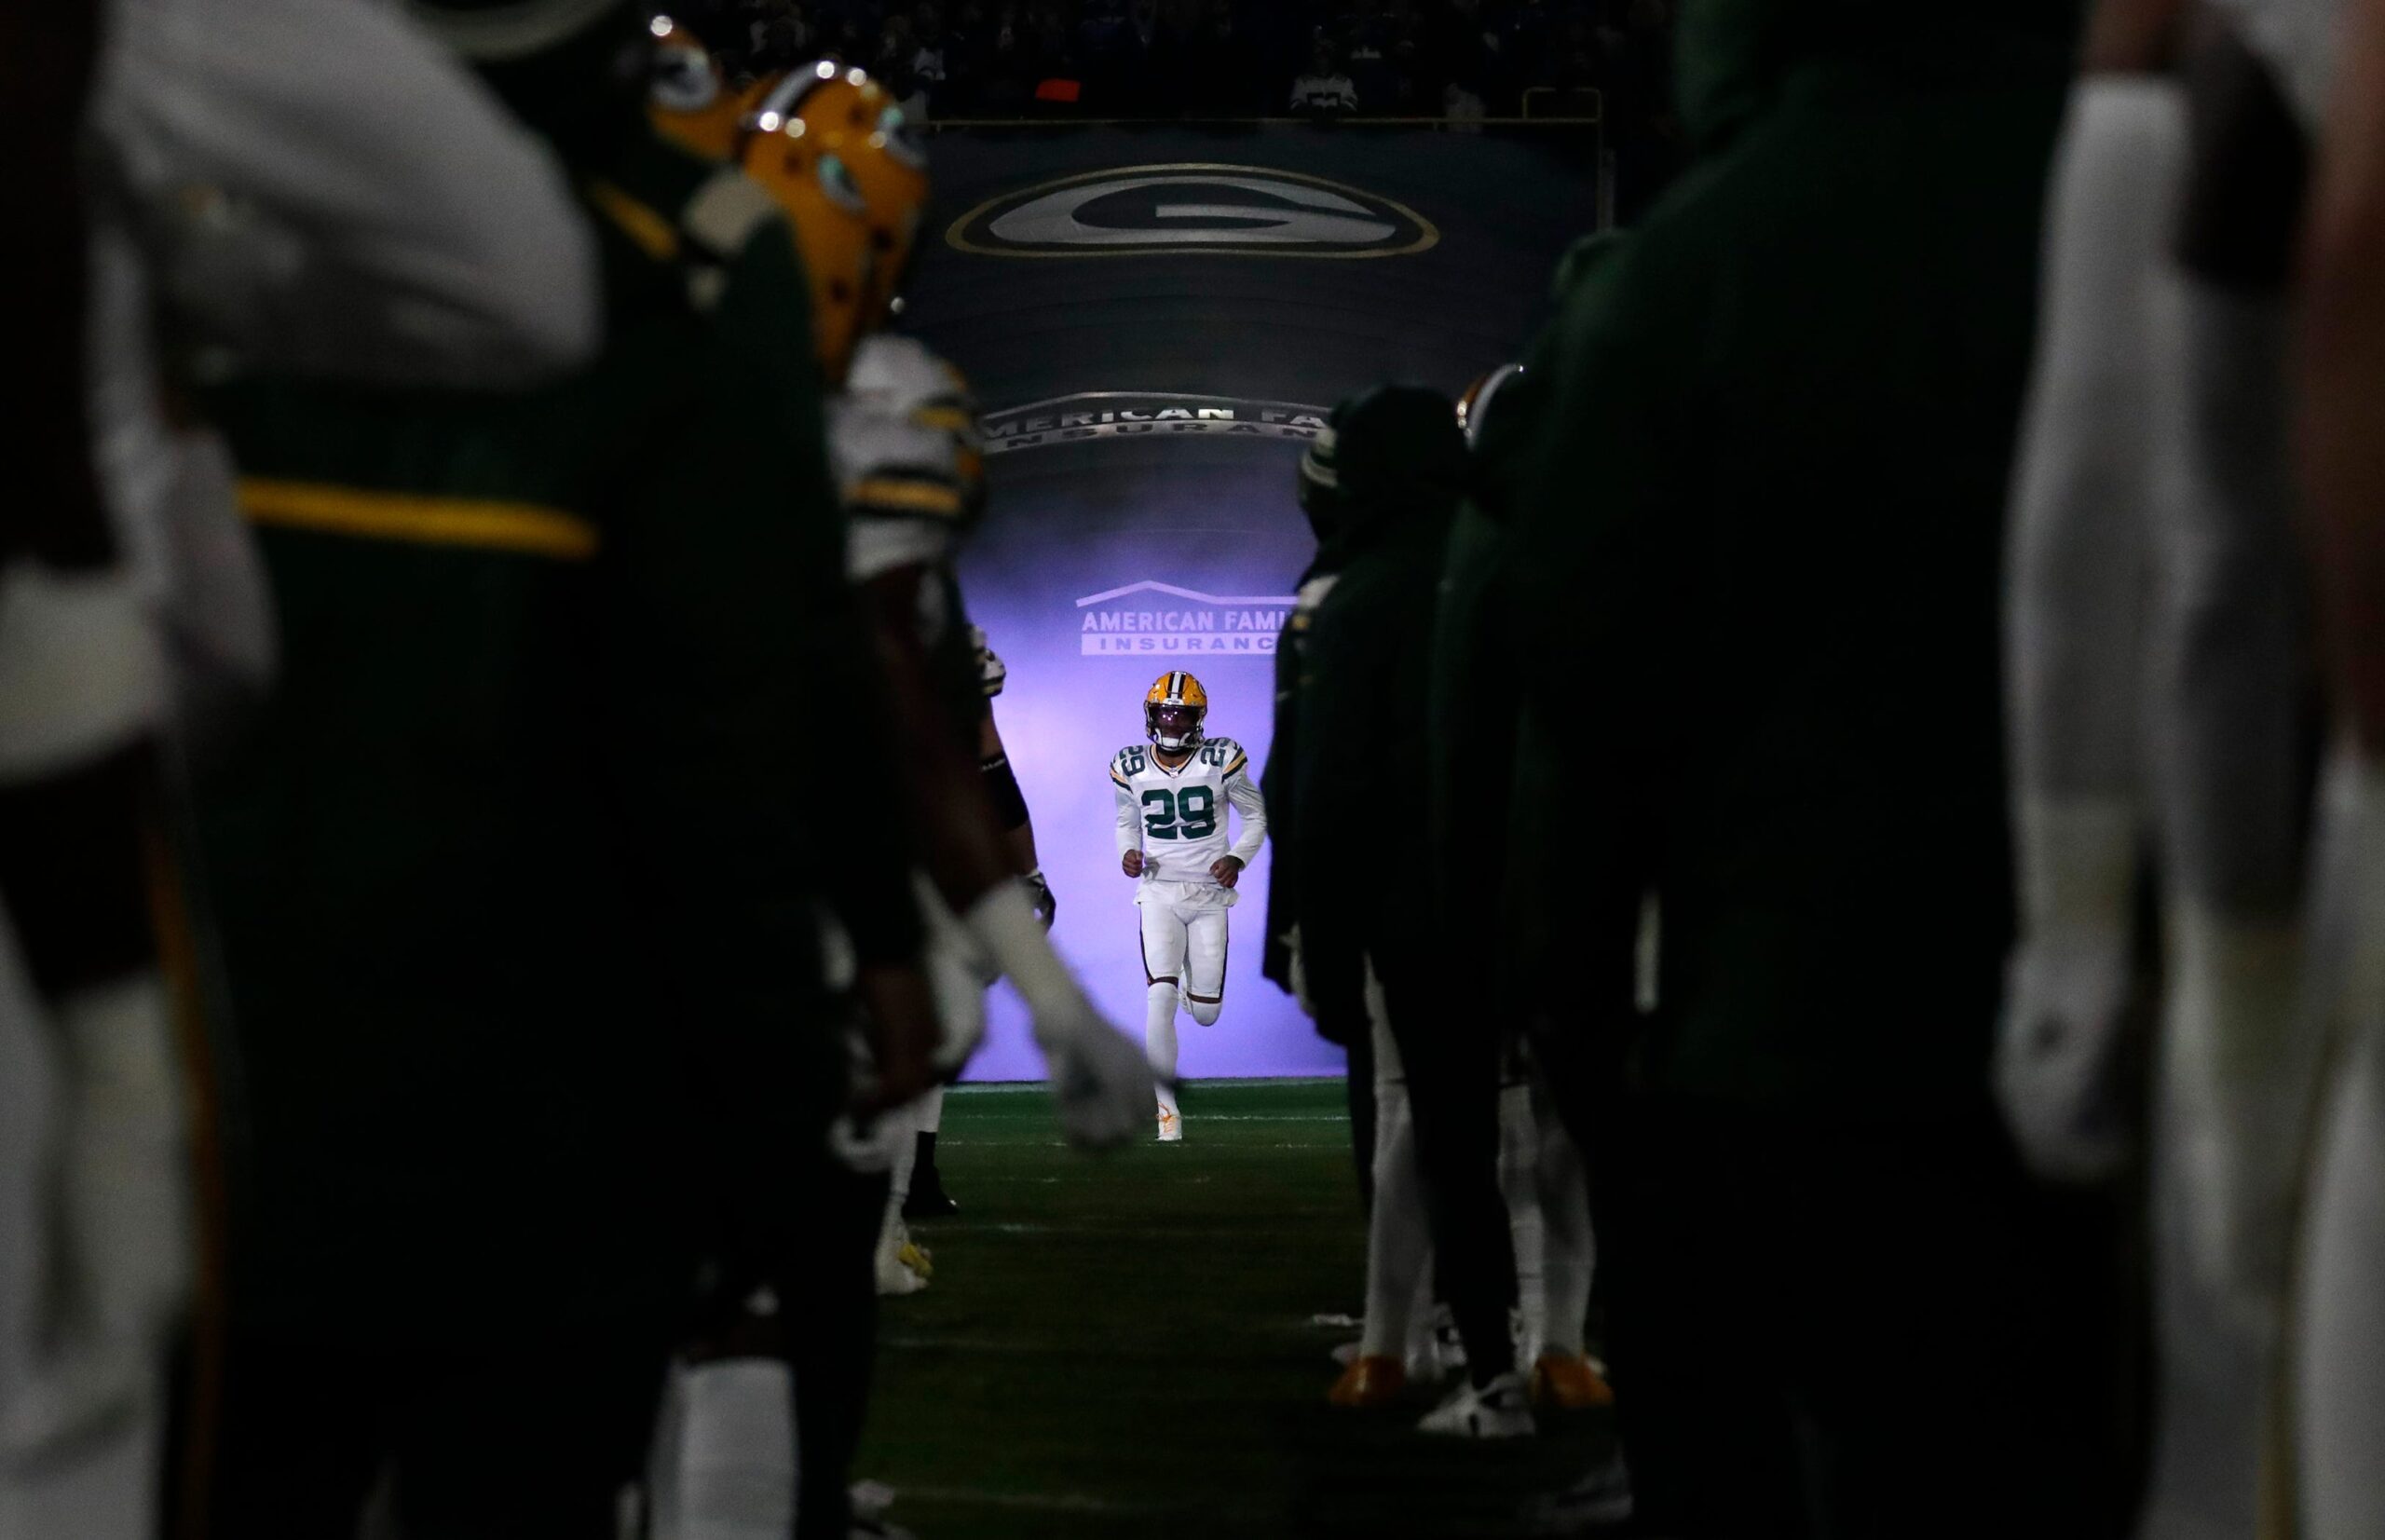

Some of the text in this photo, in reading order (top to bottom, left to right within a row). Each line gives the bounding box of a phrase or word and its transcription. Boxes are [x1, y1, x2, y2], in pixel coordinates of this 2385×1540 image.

[983, 408, 1234, 439] MERICAN
[1082, 610, 1286, 632] AMERICAN FAMI
[1100, 637, 1274, 651] INSURANC
[1141, 785, 1216, 839] 29
